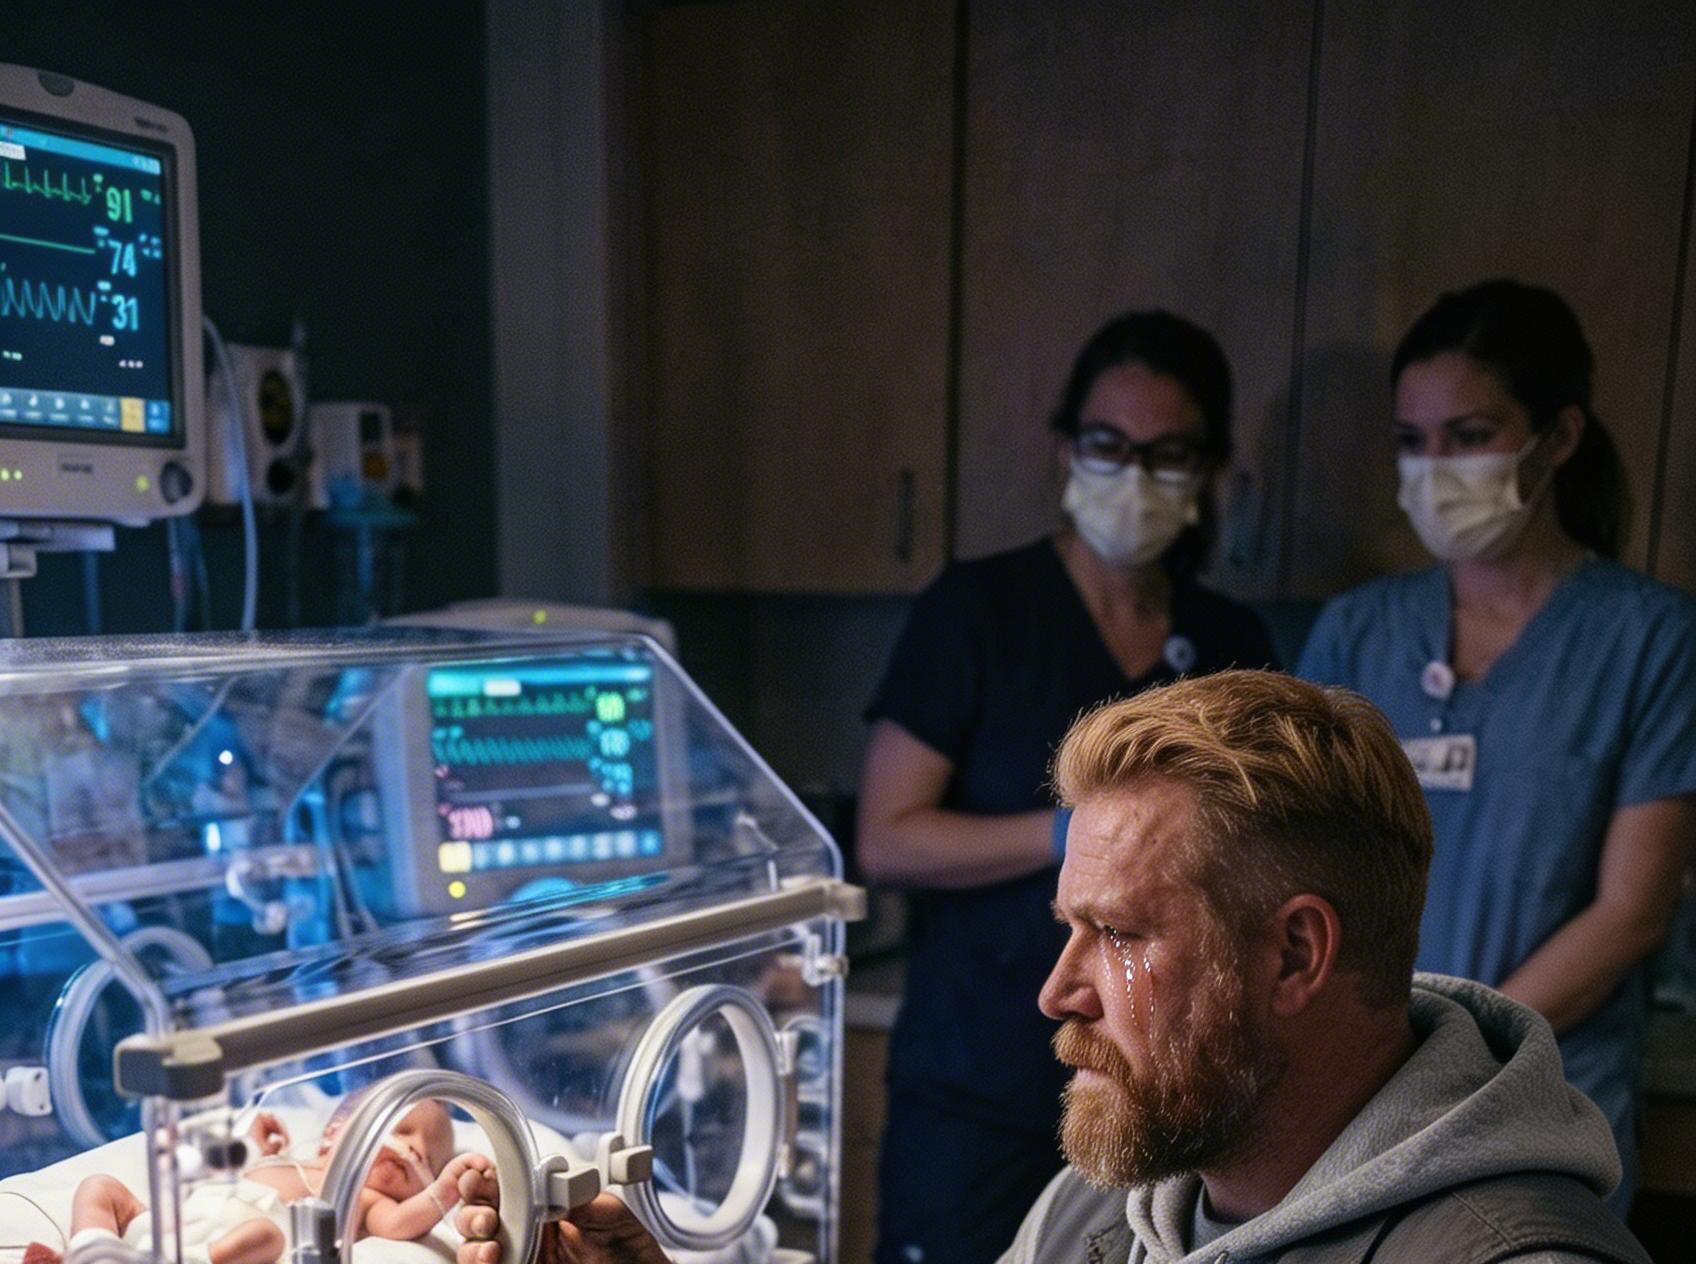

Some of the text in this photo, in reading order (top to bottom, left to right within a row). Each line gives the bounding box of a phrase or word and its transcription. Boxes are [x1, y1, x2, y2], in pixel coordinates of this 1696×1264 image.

[106, 186, 132, 223] 91
[107, 239, 136, 277] 74
[111, 294, 138, 331] 31
